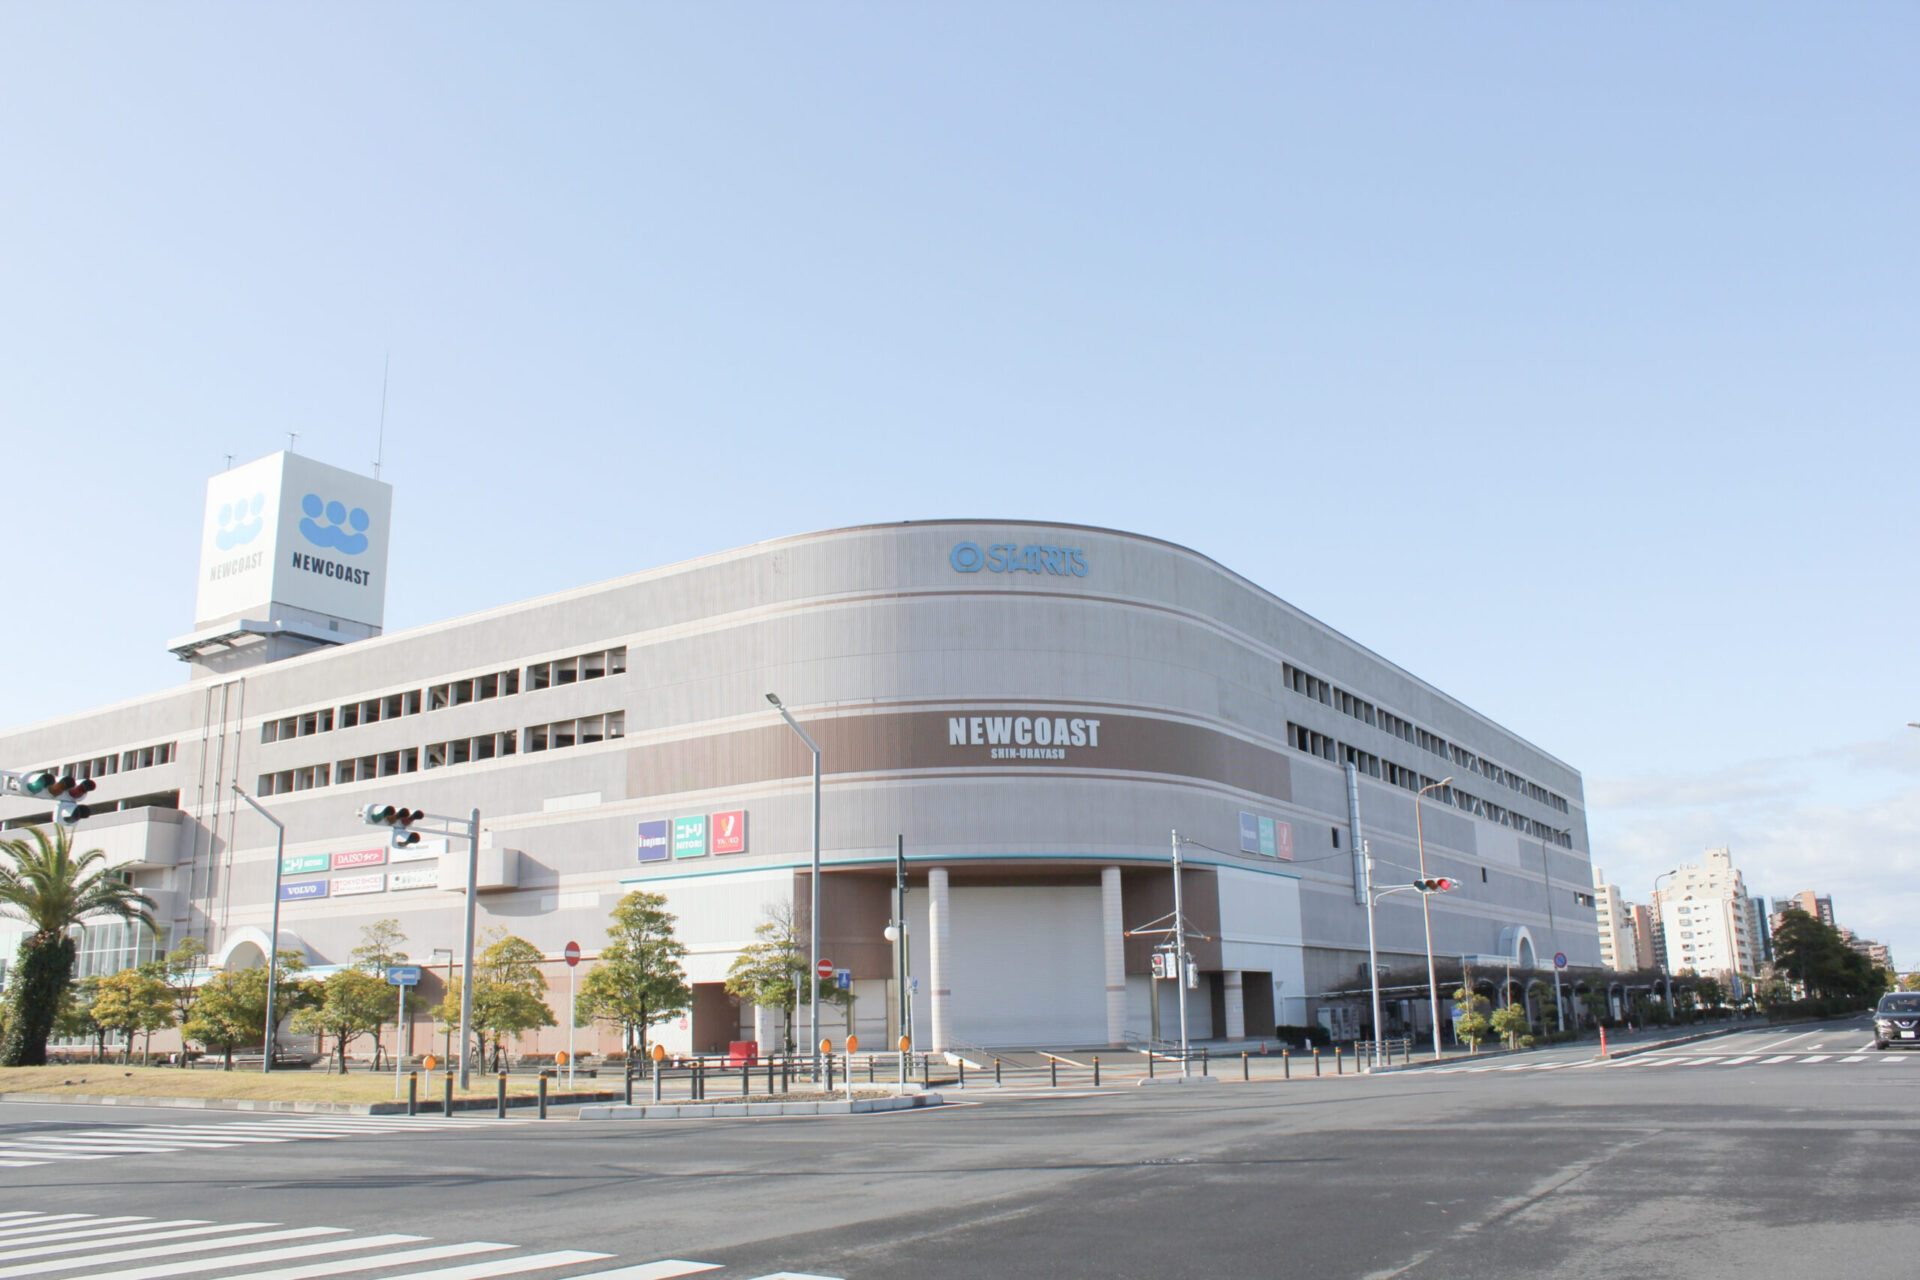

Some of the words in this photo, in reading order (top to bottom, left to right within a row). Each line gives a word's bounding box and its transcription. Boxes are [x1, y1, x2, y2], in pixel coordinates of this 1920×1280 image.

[209, 551, 264, 582] NEWCOAST
[987, 544, 1090, 577] STARTS
[292, 552, 370, 587] NEWCOAST
[949, 716, 1101, 747] NEWCOAST
[991, 748, 1066, 760] SHIN-URAYASU
[676, 823, 703, 840] ニトリ
[676, 840, 703, 850] NITORI
[284, 858, 304, 872] ニトリ
[337, 852, 363, 865] DAISO
[287, 885, 317, 895] VOLVO
